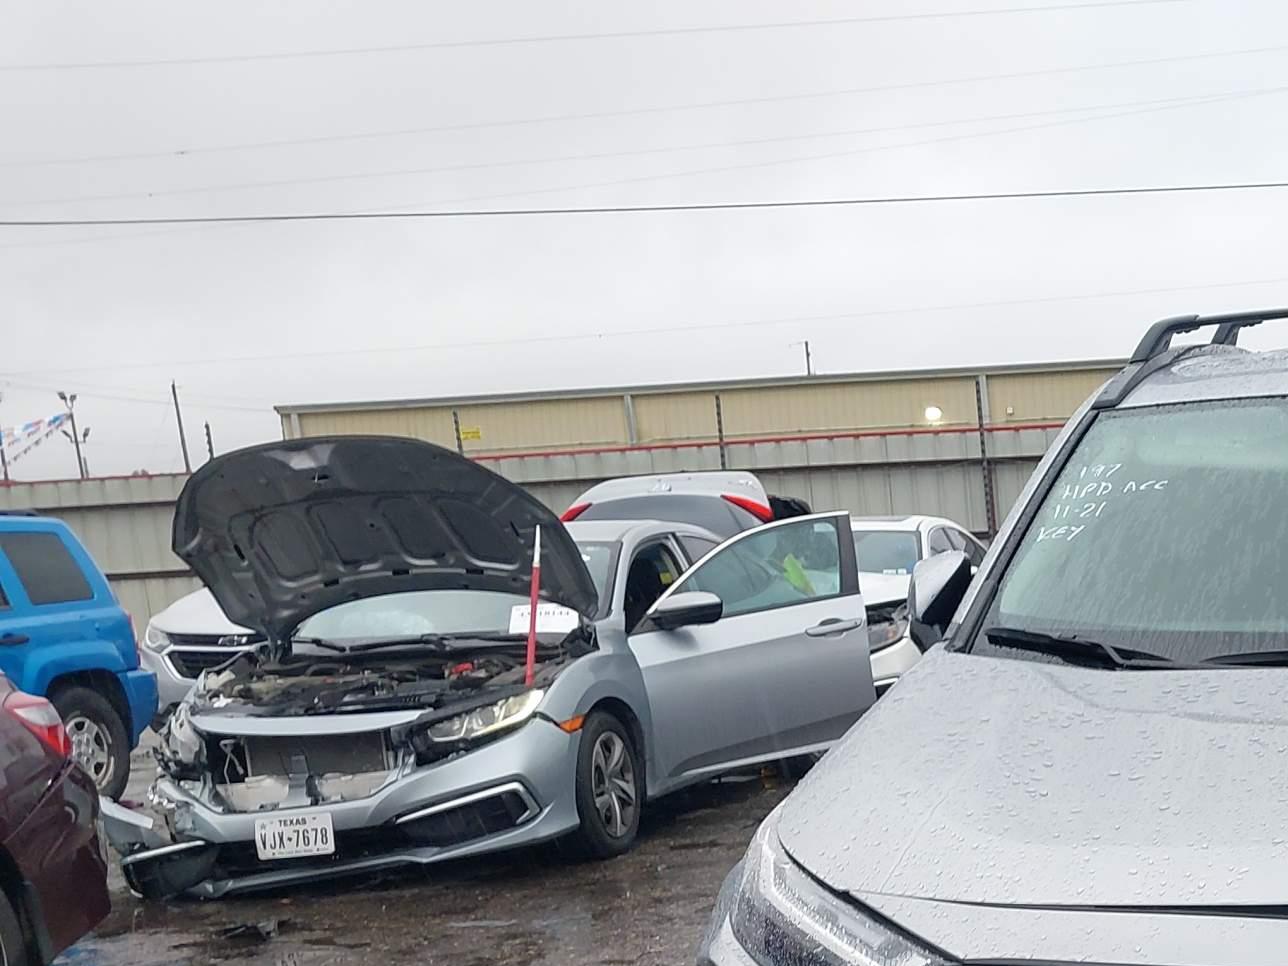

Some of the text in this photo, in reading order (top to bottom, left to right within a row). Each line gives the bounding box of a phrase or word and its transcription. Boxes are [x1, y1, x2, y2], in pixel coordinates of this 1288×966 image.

[1053, 501, 1106, 519] 11-21
[1036, 525, 1085, 542] KEY
[278, 817, 307, 827] TEXAS
